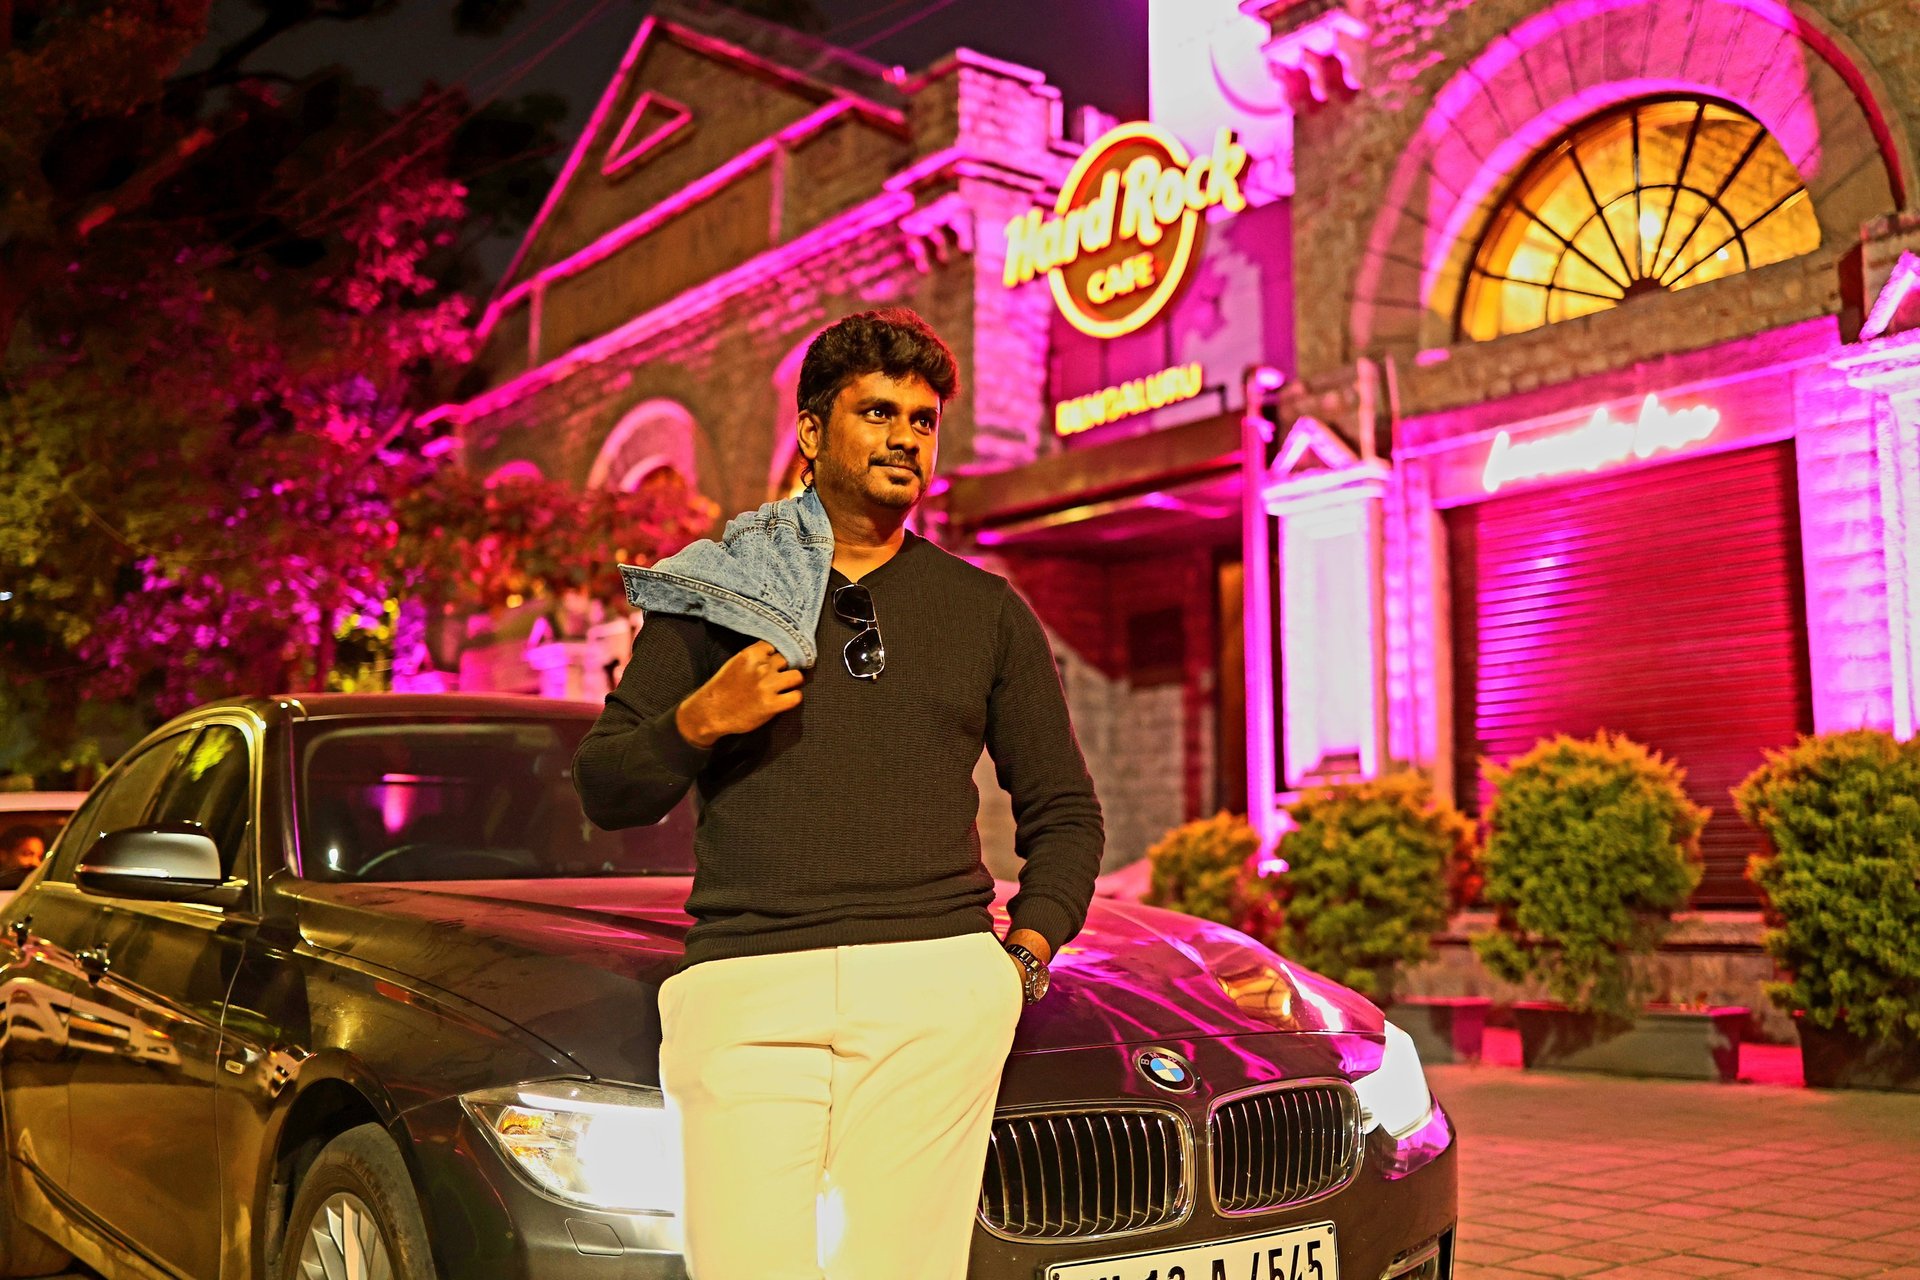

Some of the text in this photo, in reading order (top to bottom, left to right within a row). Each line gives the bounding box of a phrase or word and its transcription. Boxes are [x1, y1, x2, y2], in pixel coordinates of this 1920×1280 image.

[1003, 127, 1247, 288] Hard Rock
[1086, 252, 1155, 304] CAFE
[1056, 363, 1202, 436] BENGALURU
[1140, 1052, 1178, 1066] BMW
